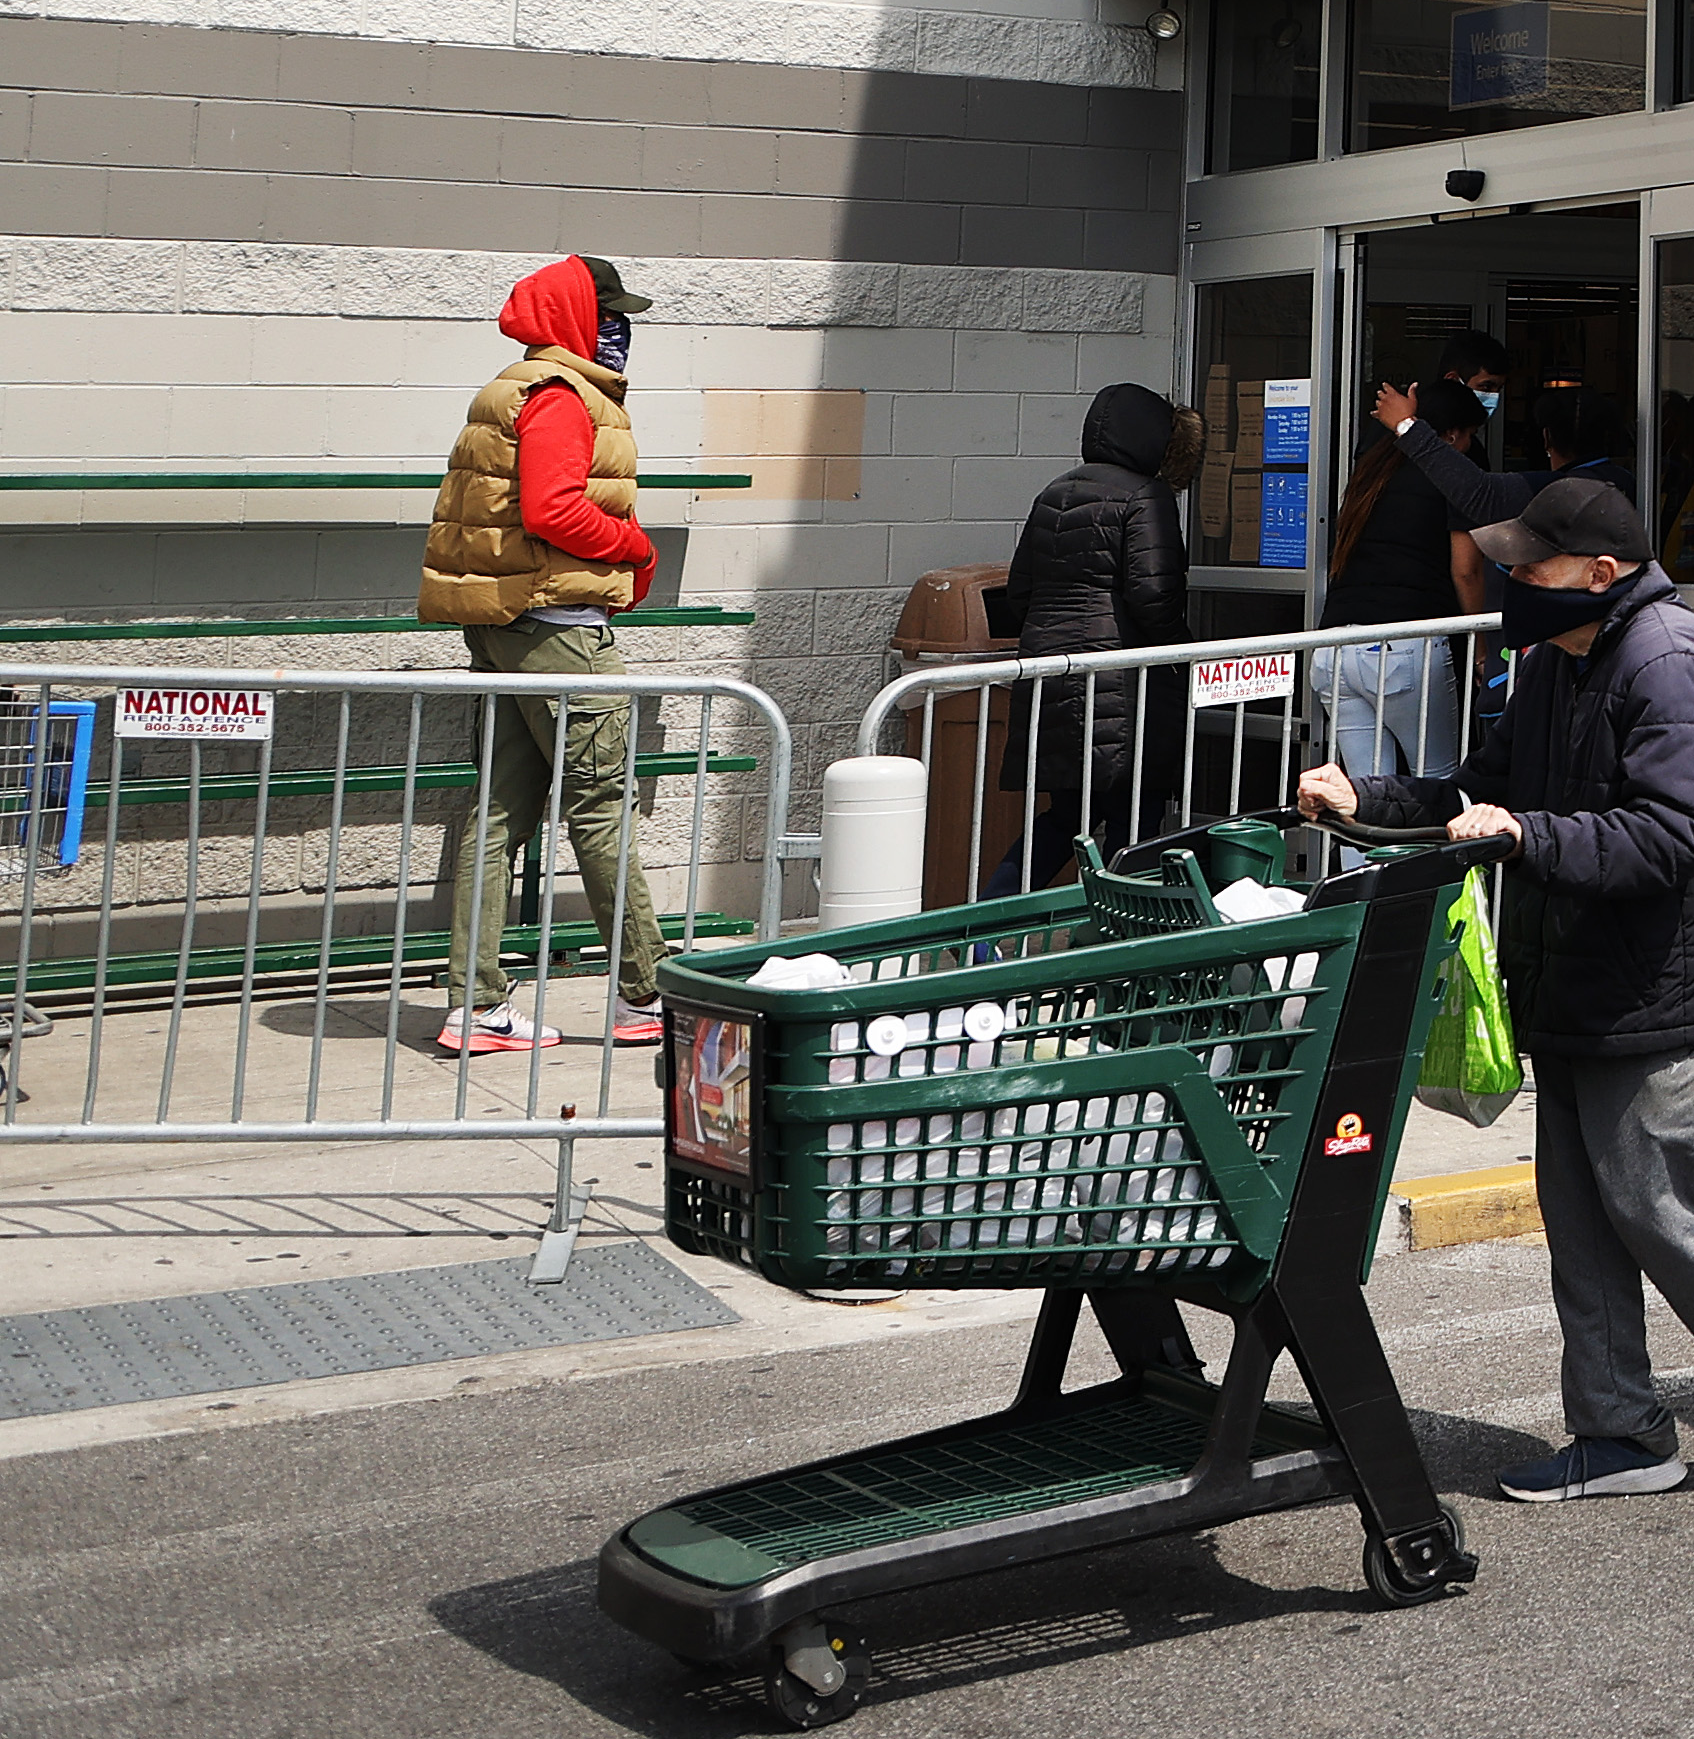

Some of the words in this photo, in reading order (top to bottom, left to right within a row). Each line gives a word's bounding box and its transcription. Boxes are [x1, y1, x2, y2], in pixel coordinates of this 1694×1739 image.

[1469, 28, 1529, 56] Welcome
[1198, 655, 1290, 686] NATIONAL
[1197, 676, 1289, 694] RENT-A-FENCE
[1210, 684, 1276, 700] 800-352-5675
[124, 690, 267, 716] NATIONAL
[123, 714, 268, 724] RENT-A-FENCE
[144, 722, 245, 733] 800-352-5675
